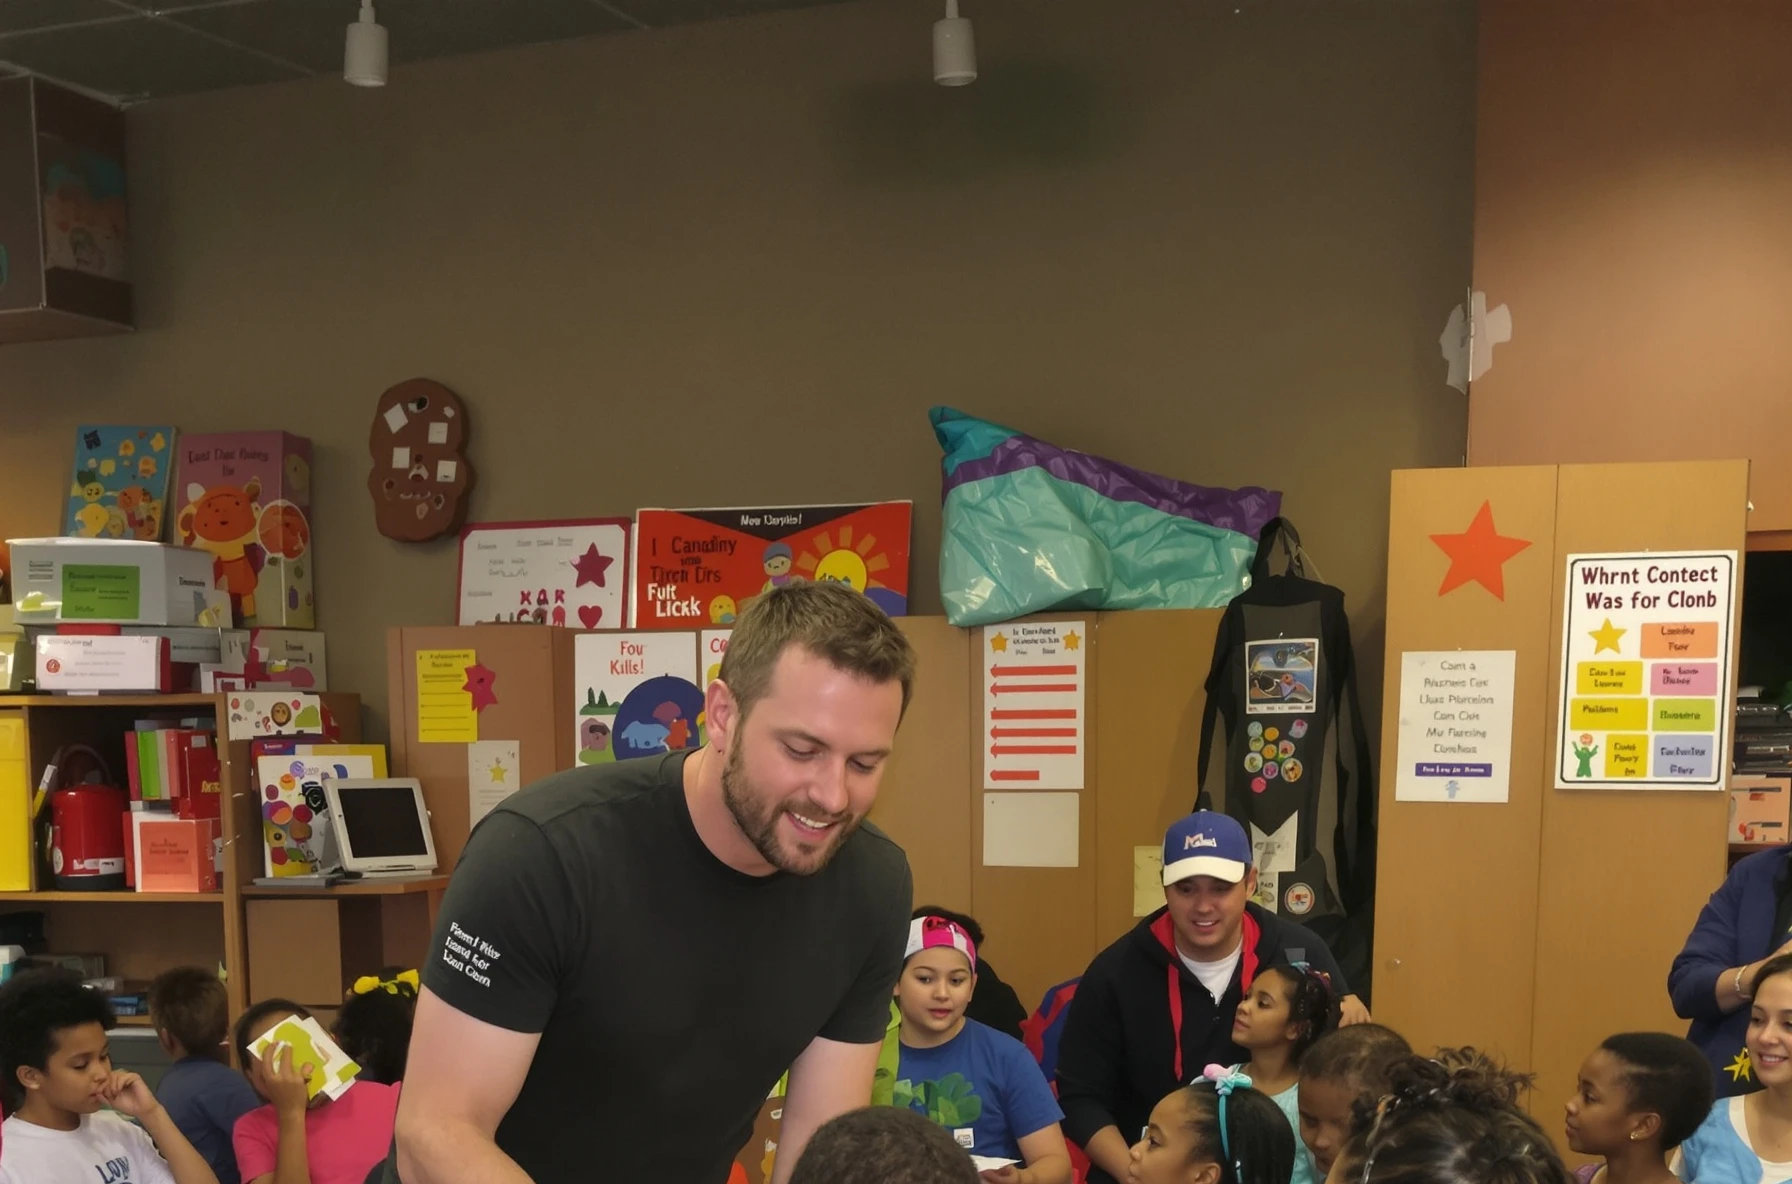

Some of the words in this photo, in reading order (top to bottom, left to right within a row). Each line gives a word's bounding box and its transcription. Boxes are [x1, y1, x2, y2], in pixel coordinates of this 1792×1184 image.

[1647, 565, 1718, 584] Contect
[1586, 592, 1623, 609] Was
[1631, 591, 1660, 609] for
[1668, 590, 1716, 608] Clonb
